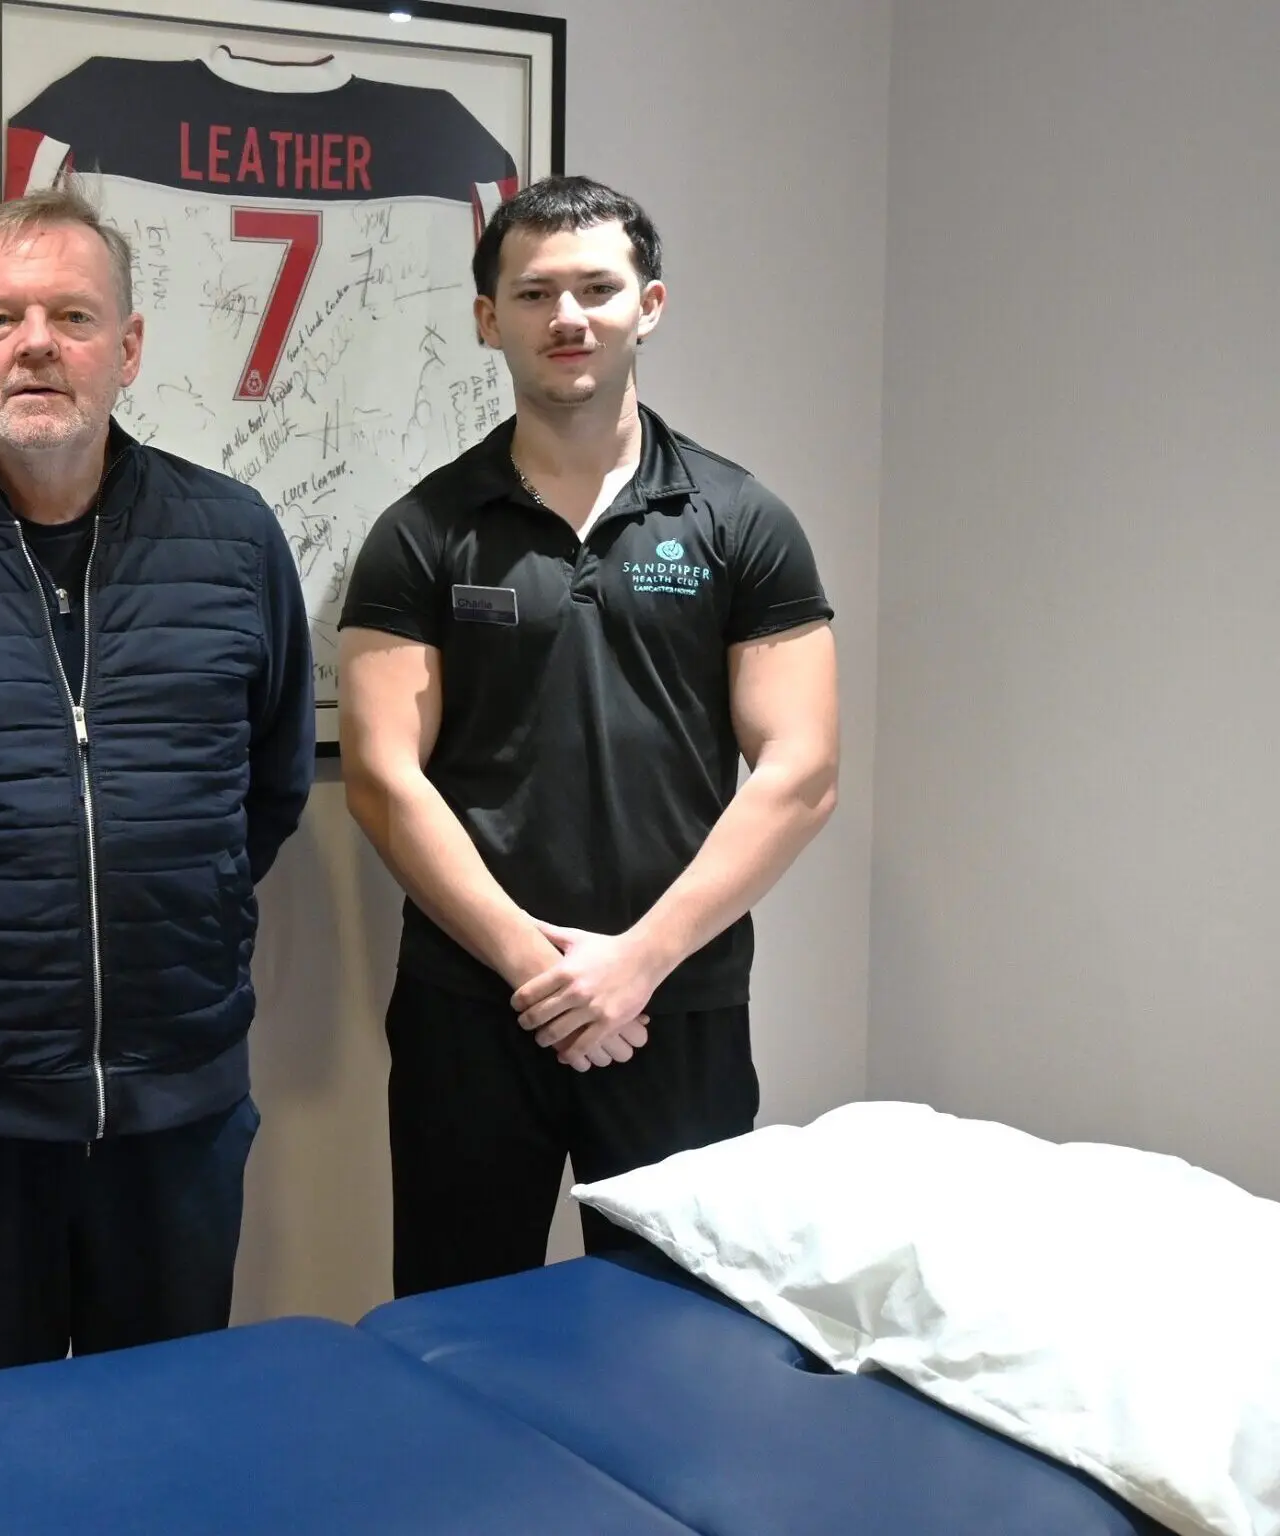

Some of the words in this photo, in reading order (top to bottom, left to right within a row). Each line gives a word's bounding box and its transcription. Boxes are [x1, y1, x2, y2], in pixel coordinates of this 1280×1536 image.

[180, 121, 372, 191] LEATHER
[230, 205, 323, 401] 7
[622, 561, 711, 580] SANDPIPER
[632, 574, 672, 584] HEALTH
[677, 577, 700, 587] CLUB
